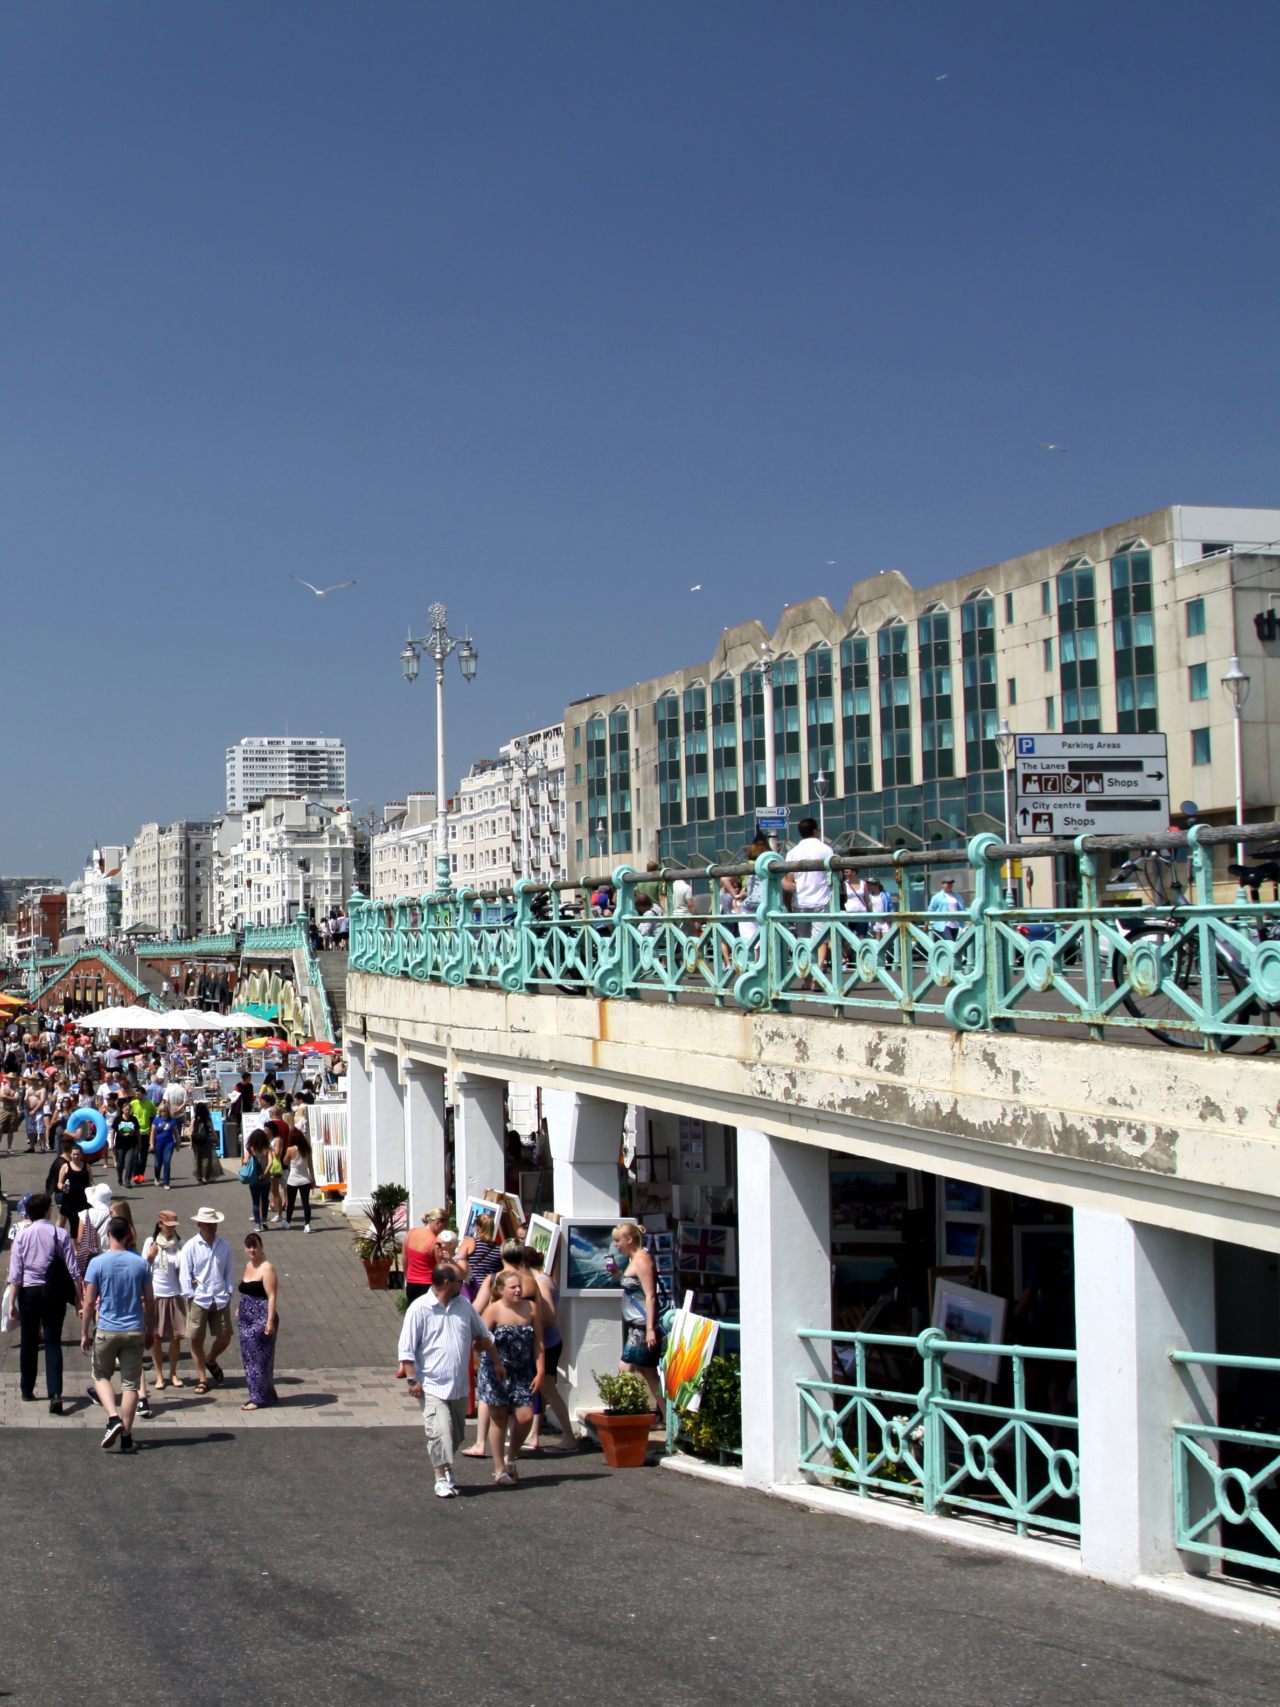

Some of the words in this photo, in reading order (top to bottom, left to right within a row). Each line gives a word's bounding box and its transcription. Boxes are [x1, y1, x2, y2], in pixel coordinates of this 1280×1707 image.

[543, 726, 563, 740] HOTEL
[1022, 739, 1033, 753] P
[1061, 741, 1094, 750] Parking
[1096, 741, 1121, 749] Areas
[1022, 762, 1038, 770] The
[1040, 762, 1066, 770] Lanes
[1107, 778, 1139, 788] Shops
[1032, 801, 1050, 810] City
[1063, 817, 1096, 827] Shops
